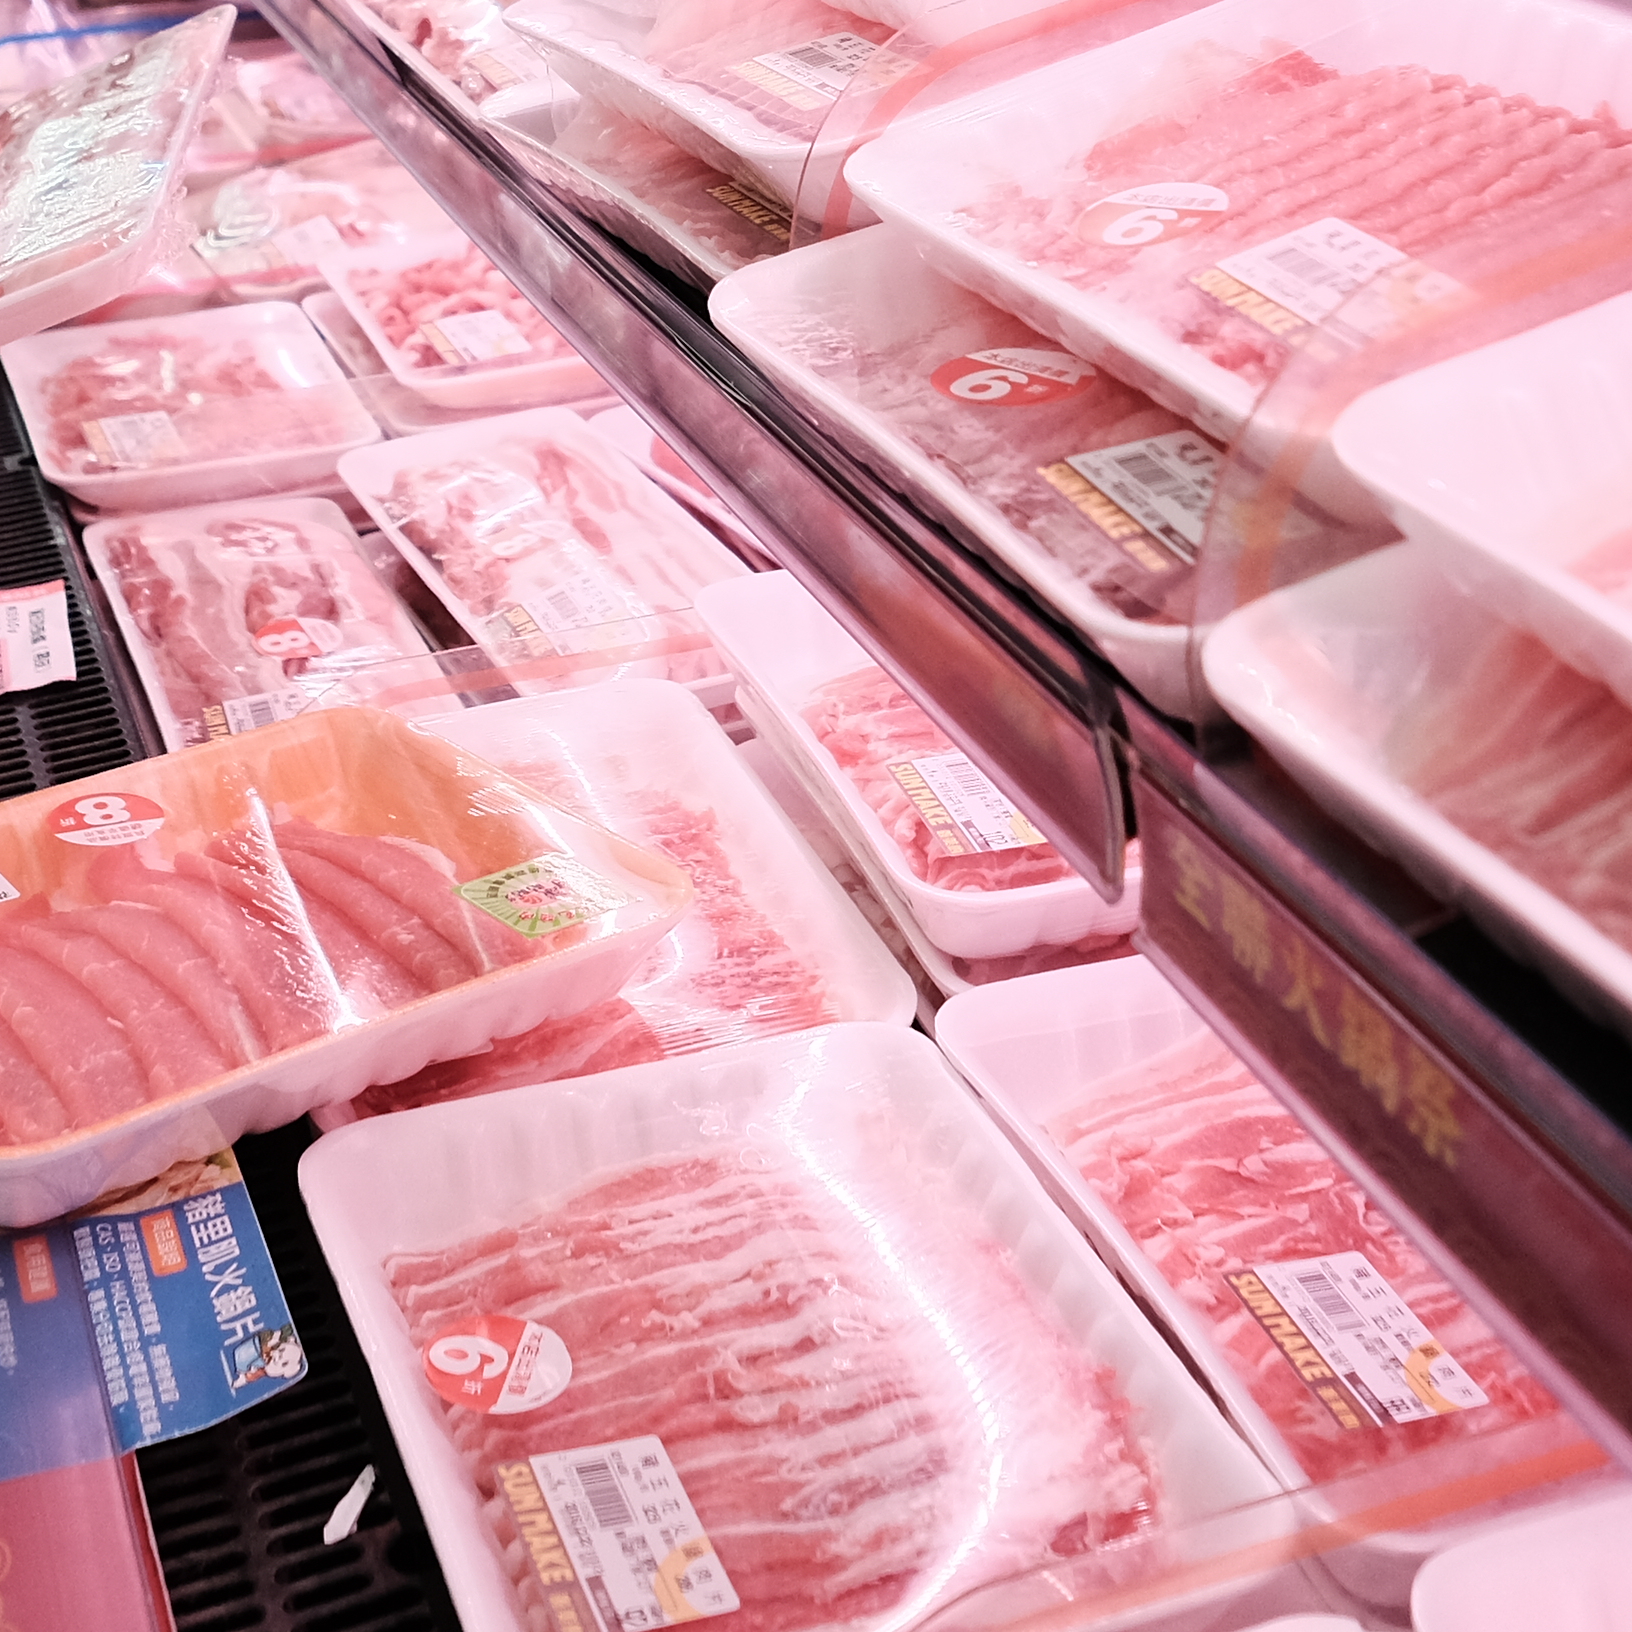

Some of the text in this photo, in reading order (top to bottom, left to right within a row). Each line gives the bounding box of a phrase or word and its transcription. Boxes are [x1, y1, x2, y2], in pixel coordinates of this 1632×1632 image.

[1103, 208, 1178, 245] 6
[950, 368, 1028, 401] 6
[73, 792, 131, 827] 8
[907, 787, 952, 826] MAKE
[182, 1191, 266, 1346] 豬里肌火鍋片
[1230, 1272, 1281, 1317] SUN
[1262, 1313, 1333, 1381] MAKE
[429, 1334, 514, 1380] 6
[520, 1509, 575, 1585] MAKE
